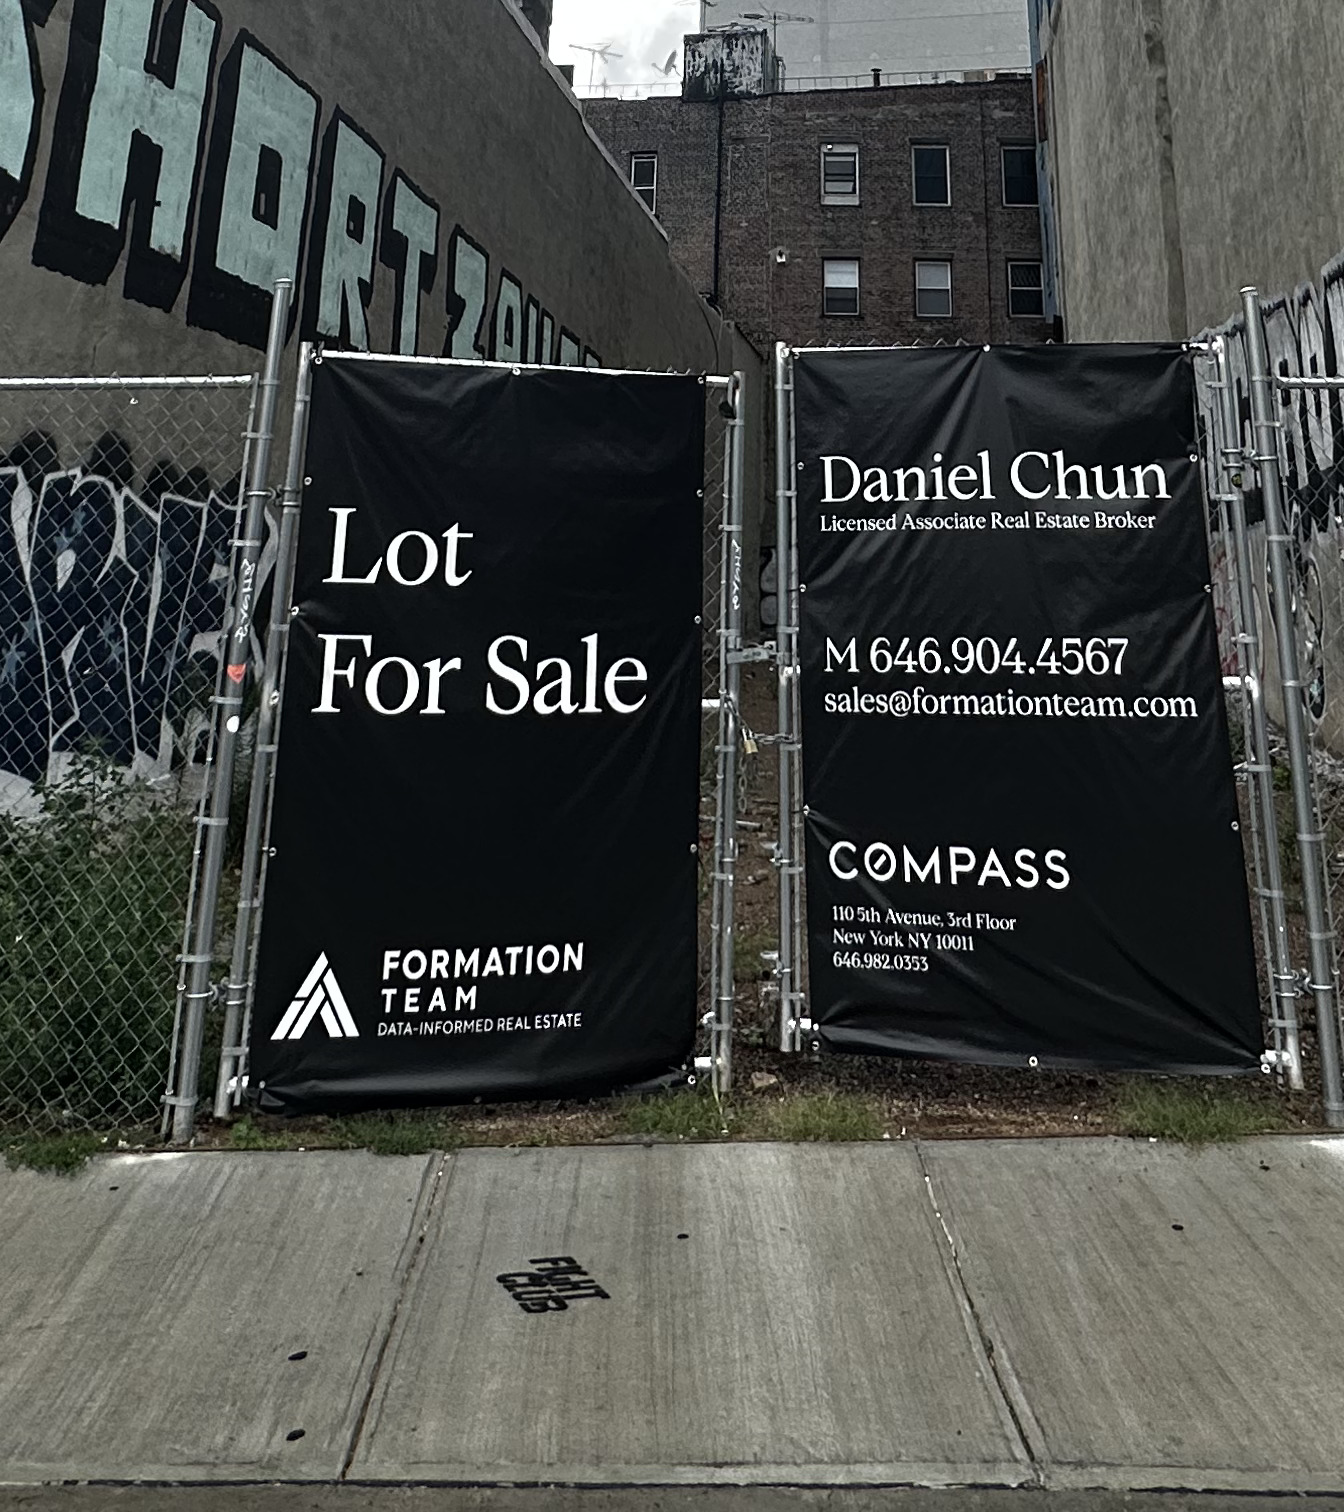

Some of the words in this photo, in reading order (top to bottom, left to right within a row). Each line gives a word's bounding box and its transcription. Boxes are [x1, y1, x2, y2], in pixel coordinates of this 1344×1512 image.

[819, 449, 997, 503] Daniel
[1010, 449, 1172, 501] Chun
[820, 513, 897, 532] Licensed
[901, 512, 987, 530] Associate
[990, 511, 1031, 529] Real
[1034, 510, 1091, 529] Estate
[1094, 510, 1157, 529] Broker
[321, 507, 474, 587] Lot
[823, 636, 860, 674] M
[869, 636, 1129, 676] 646.904.4567
[310, 633, 462, 715] For
[485, 632, 648, 716] Sale
[824, 685, 1199, 719] sales@formationteam.com
[828, 840, 1071, 890] COMPASS
[832, 905, 855, 921] 110
[857, 906, 881, 923] 5th
[884, 908, 944, 928] Avenue,
[946, 911, 972, 928] 3rd
[975, 912, 1017, 930] Floor
[832, 928, 866, 945] New
[869, 929, 904, 948] York
[908, 932, 932, 949] NY
[935, 934, 974, 951] 10011
[382, 941, 584, 981] FORMATION
[832, 951, 929, 971] 646.982.0353
[381, 985, 477, 1014] TEAM
[377, 1018, 494, 1037] DATA-INFORMED
[496, 1015, 532, 1032] REAL
[534, 1011, 582, 1030] ESTATE
